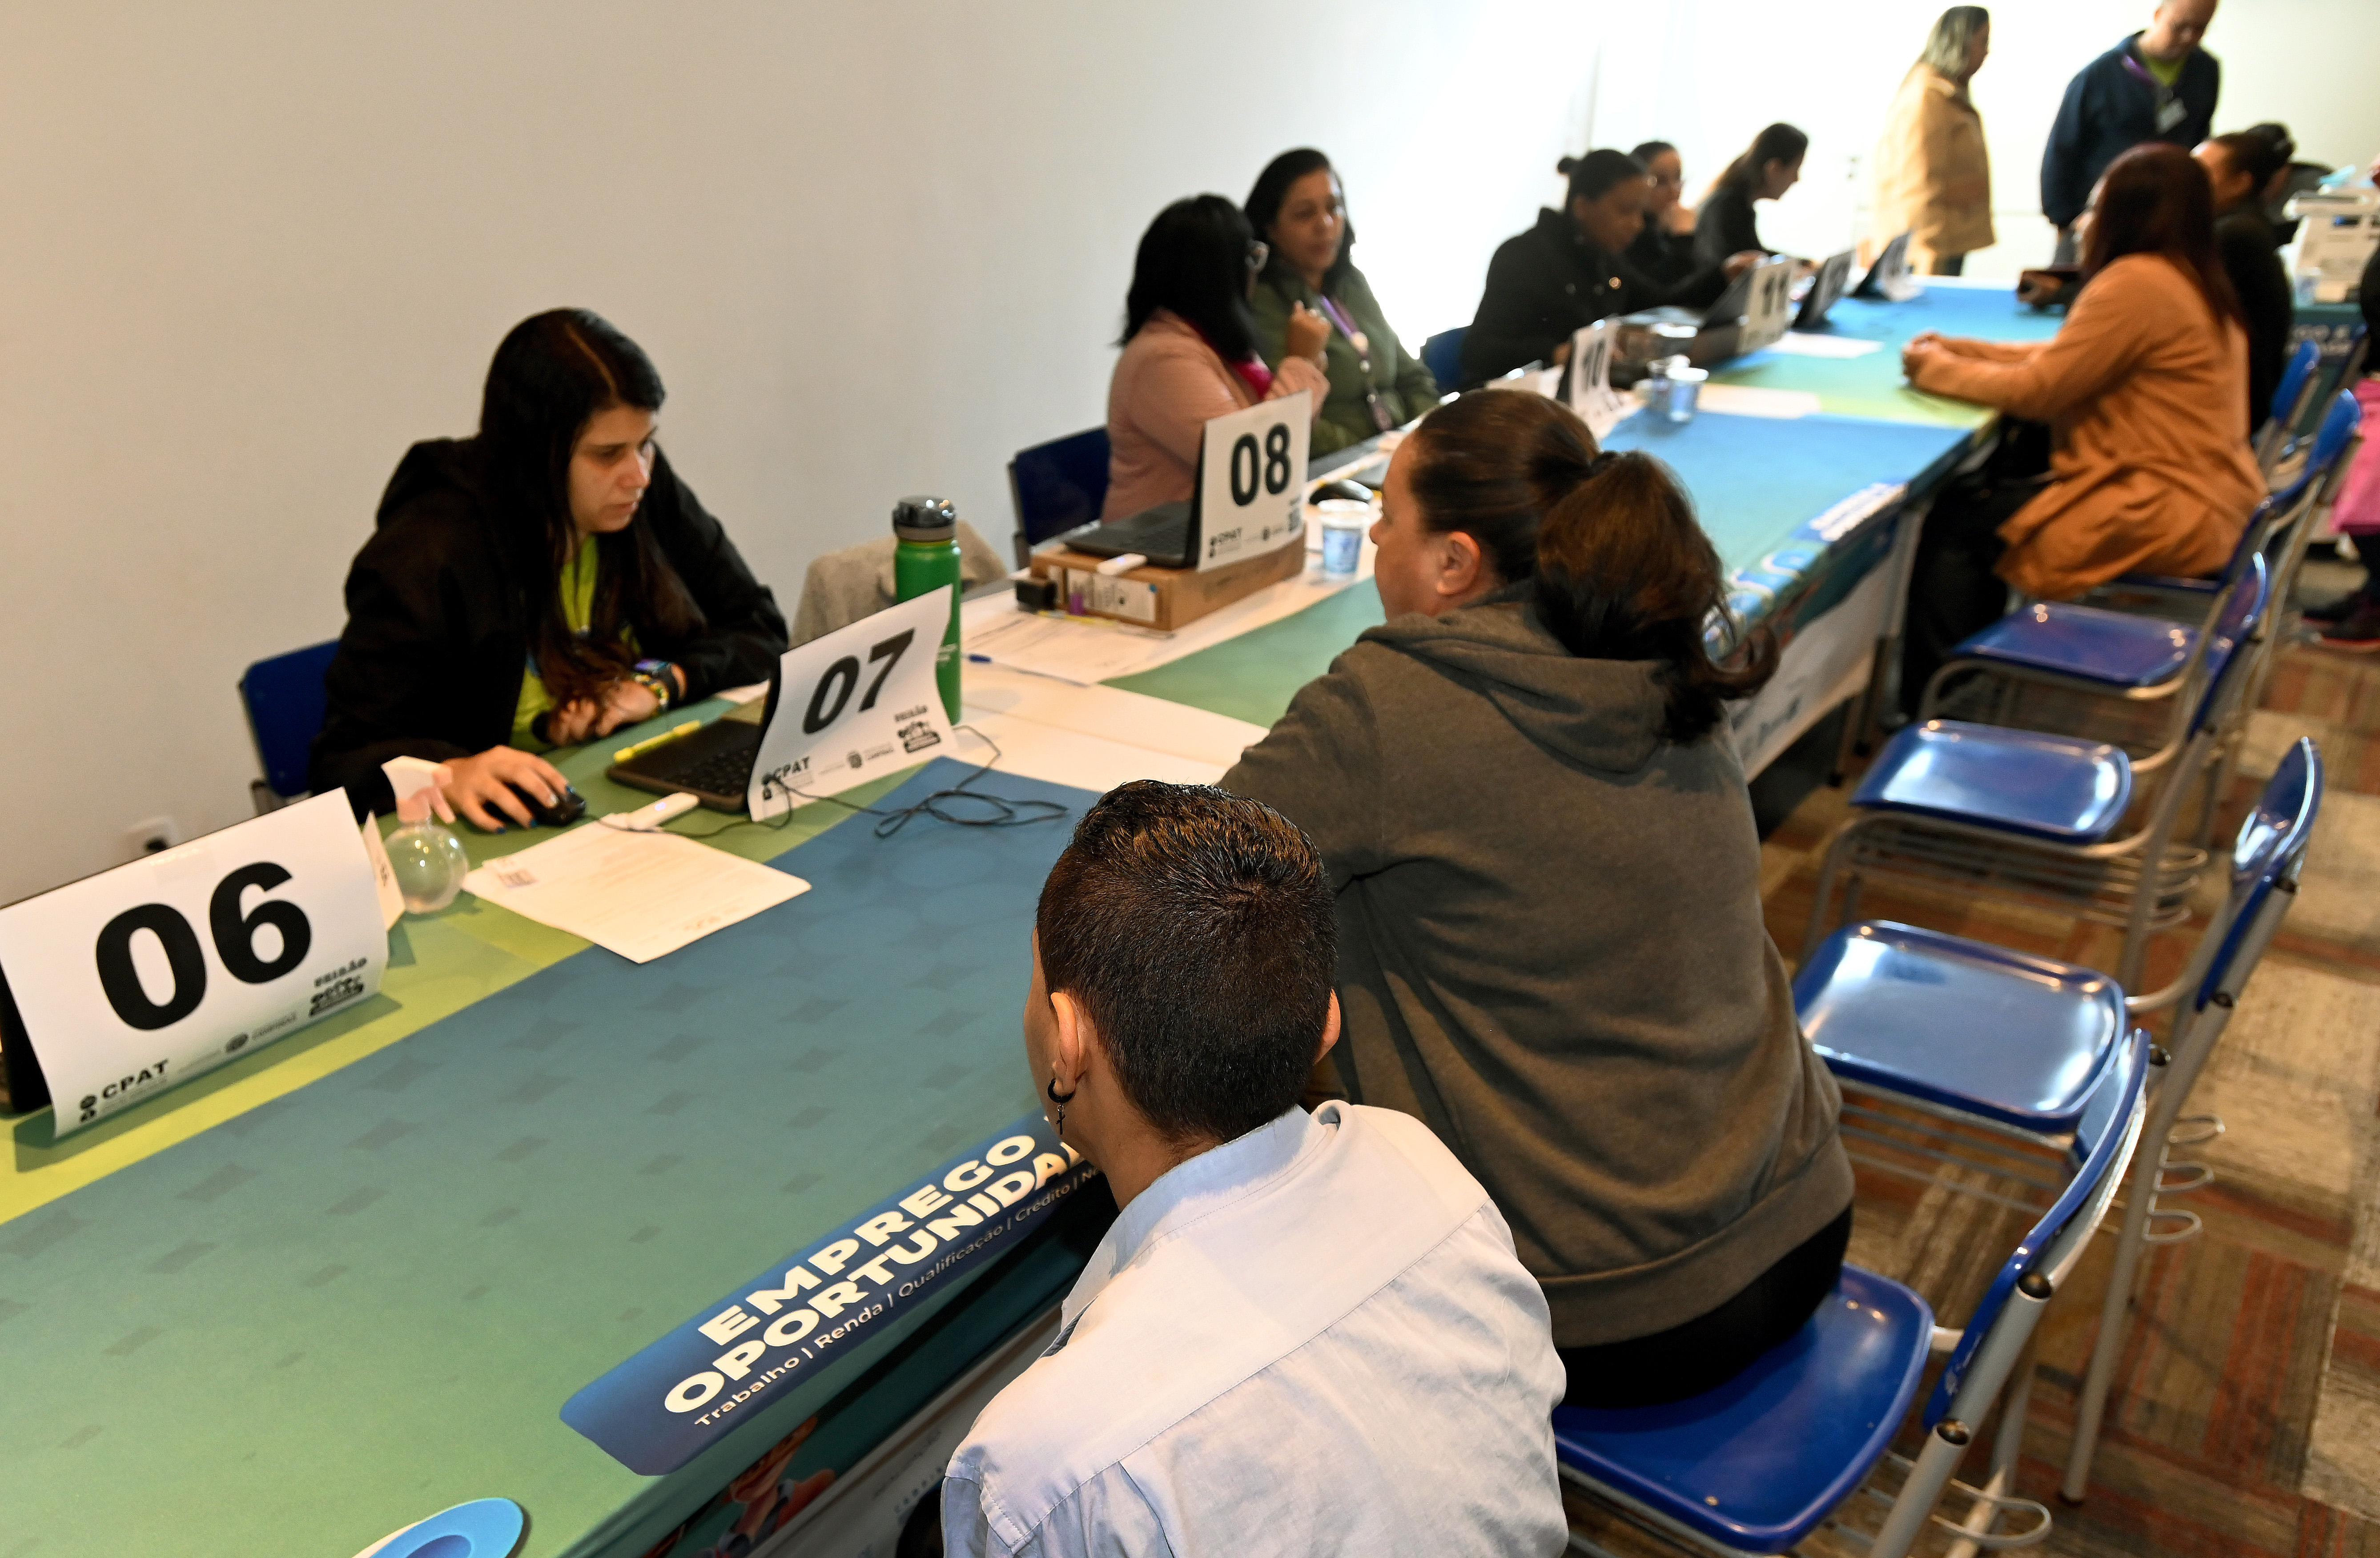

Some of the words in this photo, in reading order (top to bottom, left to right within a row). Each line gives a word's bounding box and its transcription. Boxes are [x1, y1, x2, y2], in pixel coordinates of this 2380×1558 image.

[1230, 422, 1292, 507] 08
[803, 626, 916, 735] 07
[95, 861, 312, 1032] 06
[102, 1059, 169, 1099] CPAT
[694, 1357, 800, 1425] Trabalho
[814, 1302, 883, 1349] Renda
[899, 1225, 1004, 1297] Qualificação
[1015, 1184, 1070, 1221] Crédito
[697, 1134, 1036, 1346] EMPREGO
